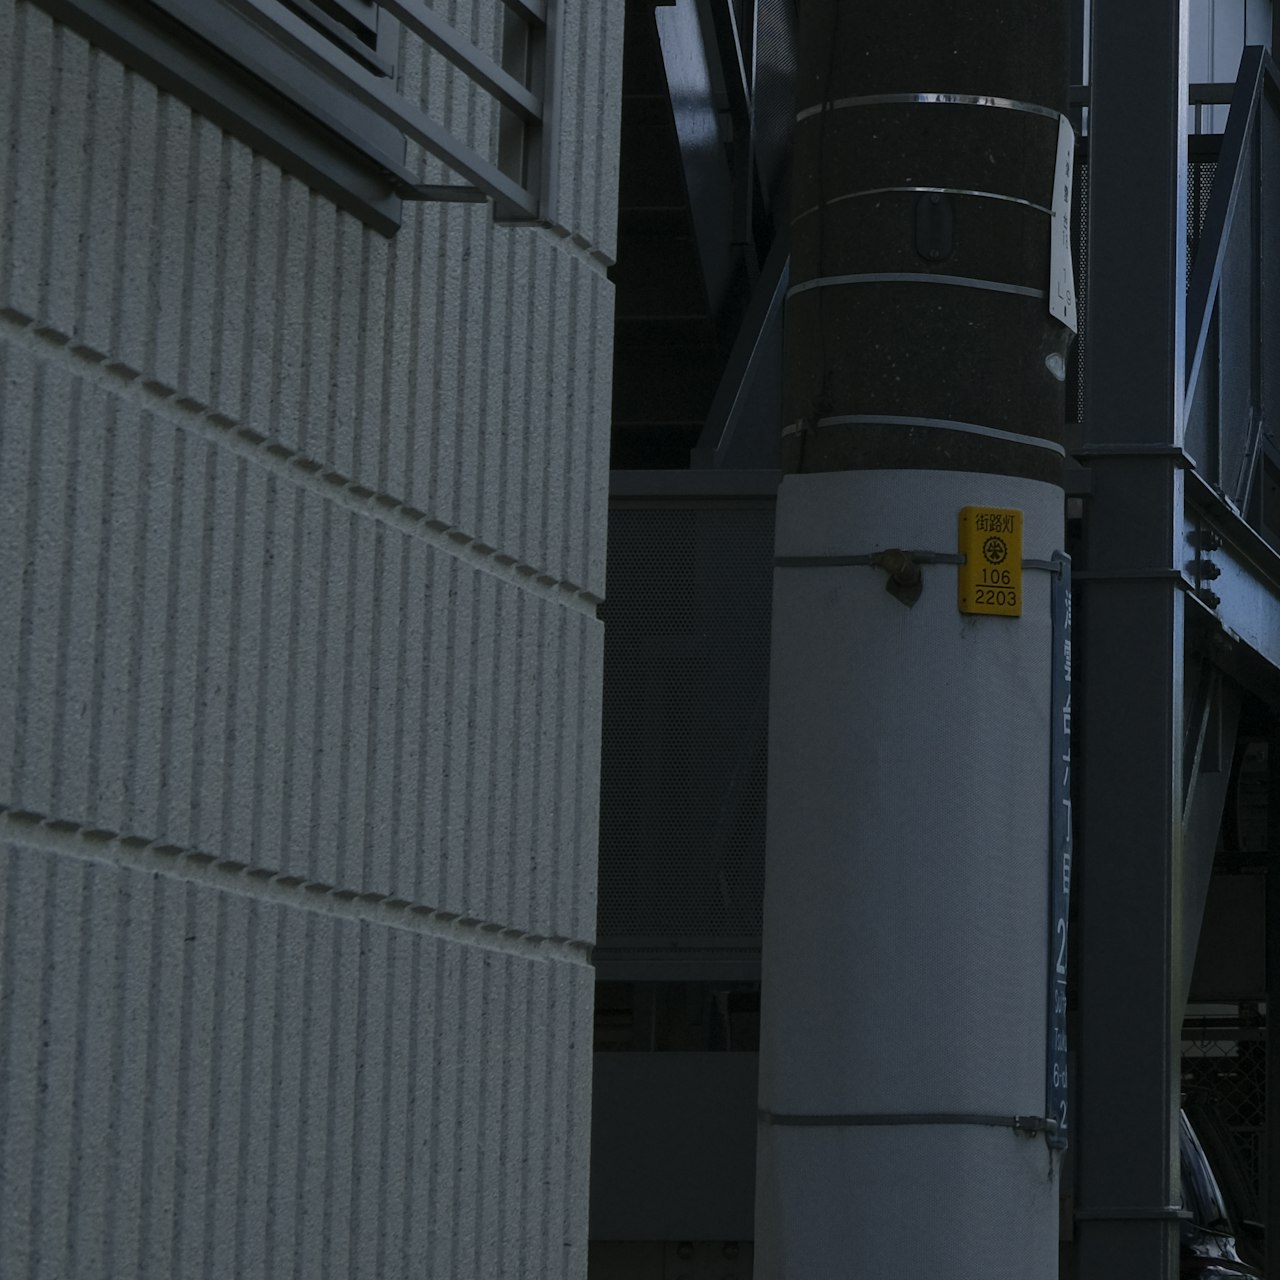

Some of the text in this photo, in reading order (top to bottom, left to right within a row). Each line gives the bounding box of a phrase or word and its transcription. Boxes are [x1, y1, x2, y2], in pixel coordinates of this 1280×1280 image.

[975, 513, 1015, 533] 街路灯
[981, 568, 1011, 585] 106
[975, 589, 1017, 607] 2203
